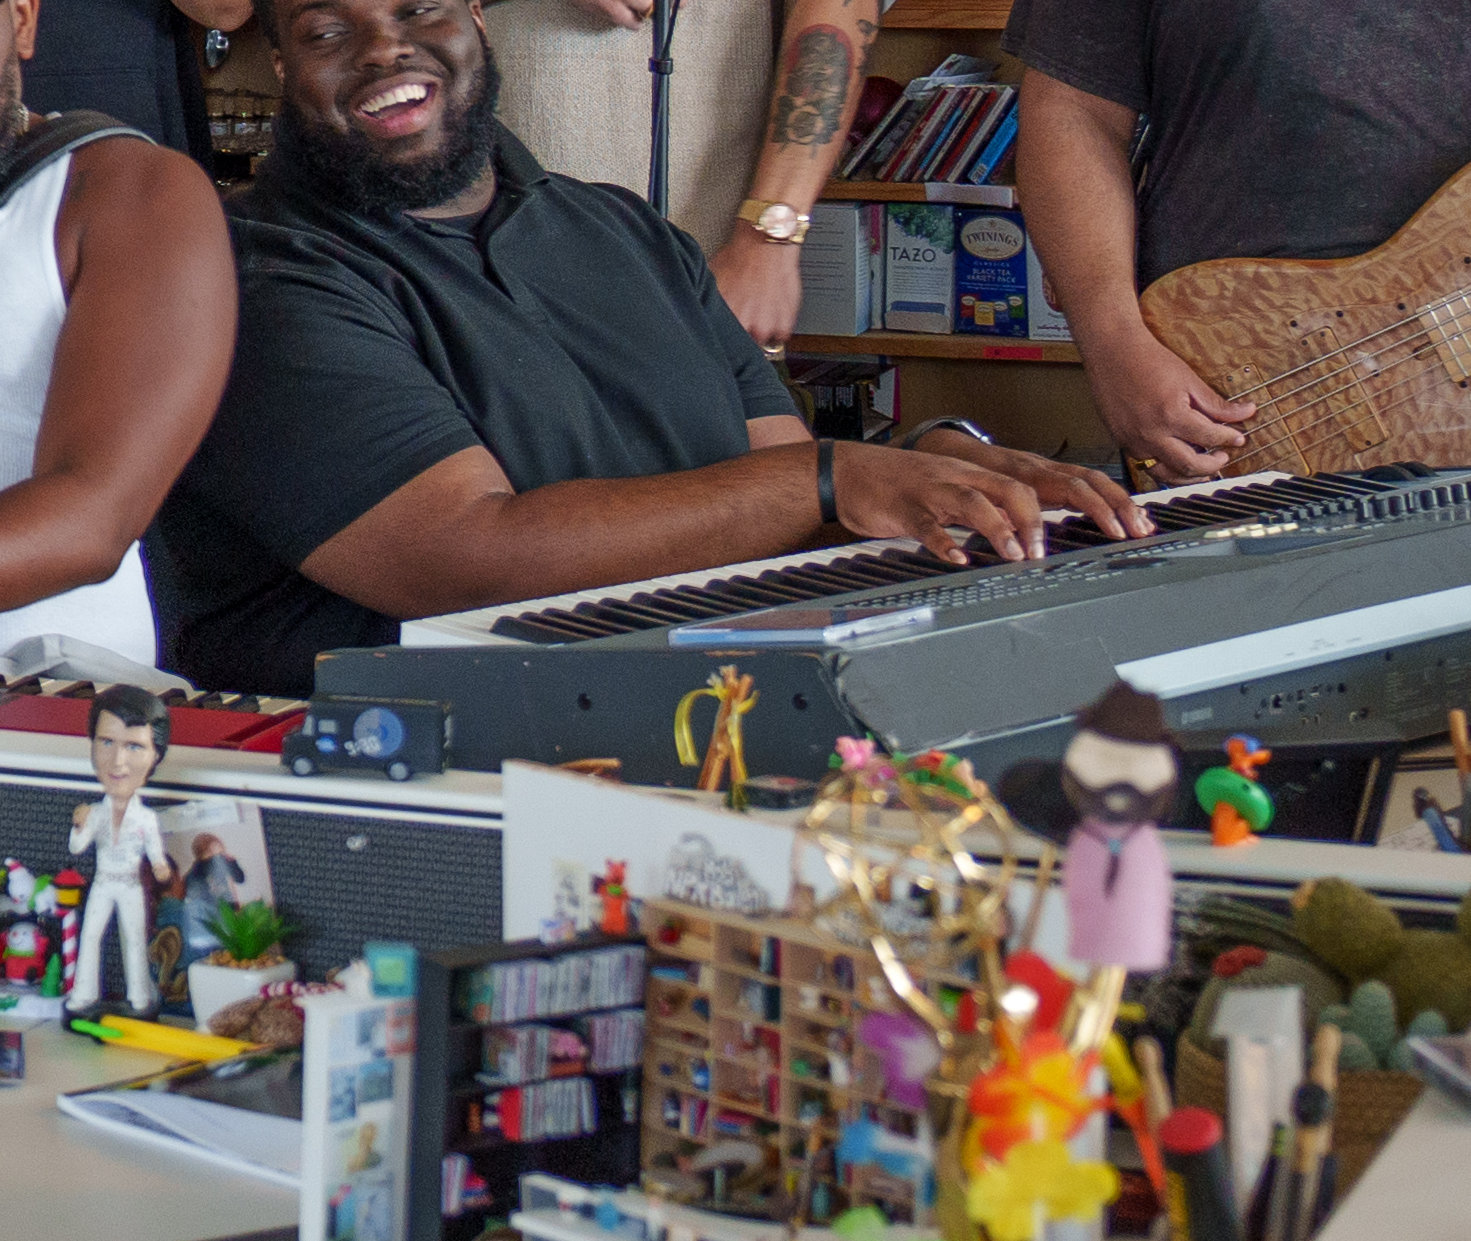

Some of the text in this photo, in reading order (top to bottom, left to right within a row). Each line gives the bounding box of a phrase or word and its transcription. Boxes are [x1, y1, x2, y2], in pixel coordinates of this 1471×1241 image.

[965, 231, 1020, 248] TWININGS
[889, 246, 937, 263] TAZO
[966, 274, 1016, 284] VARIETY PACK
[972, 268, 1011, 277] BLACK TEA
